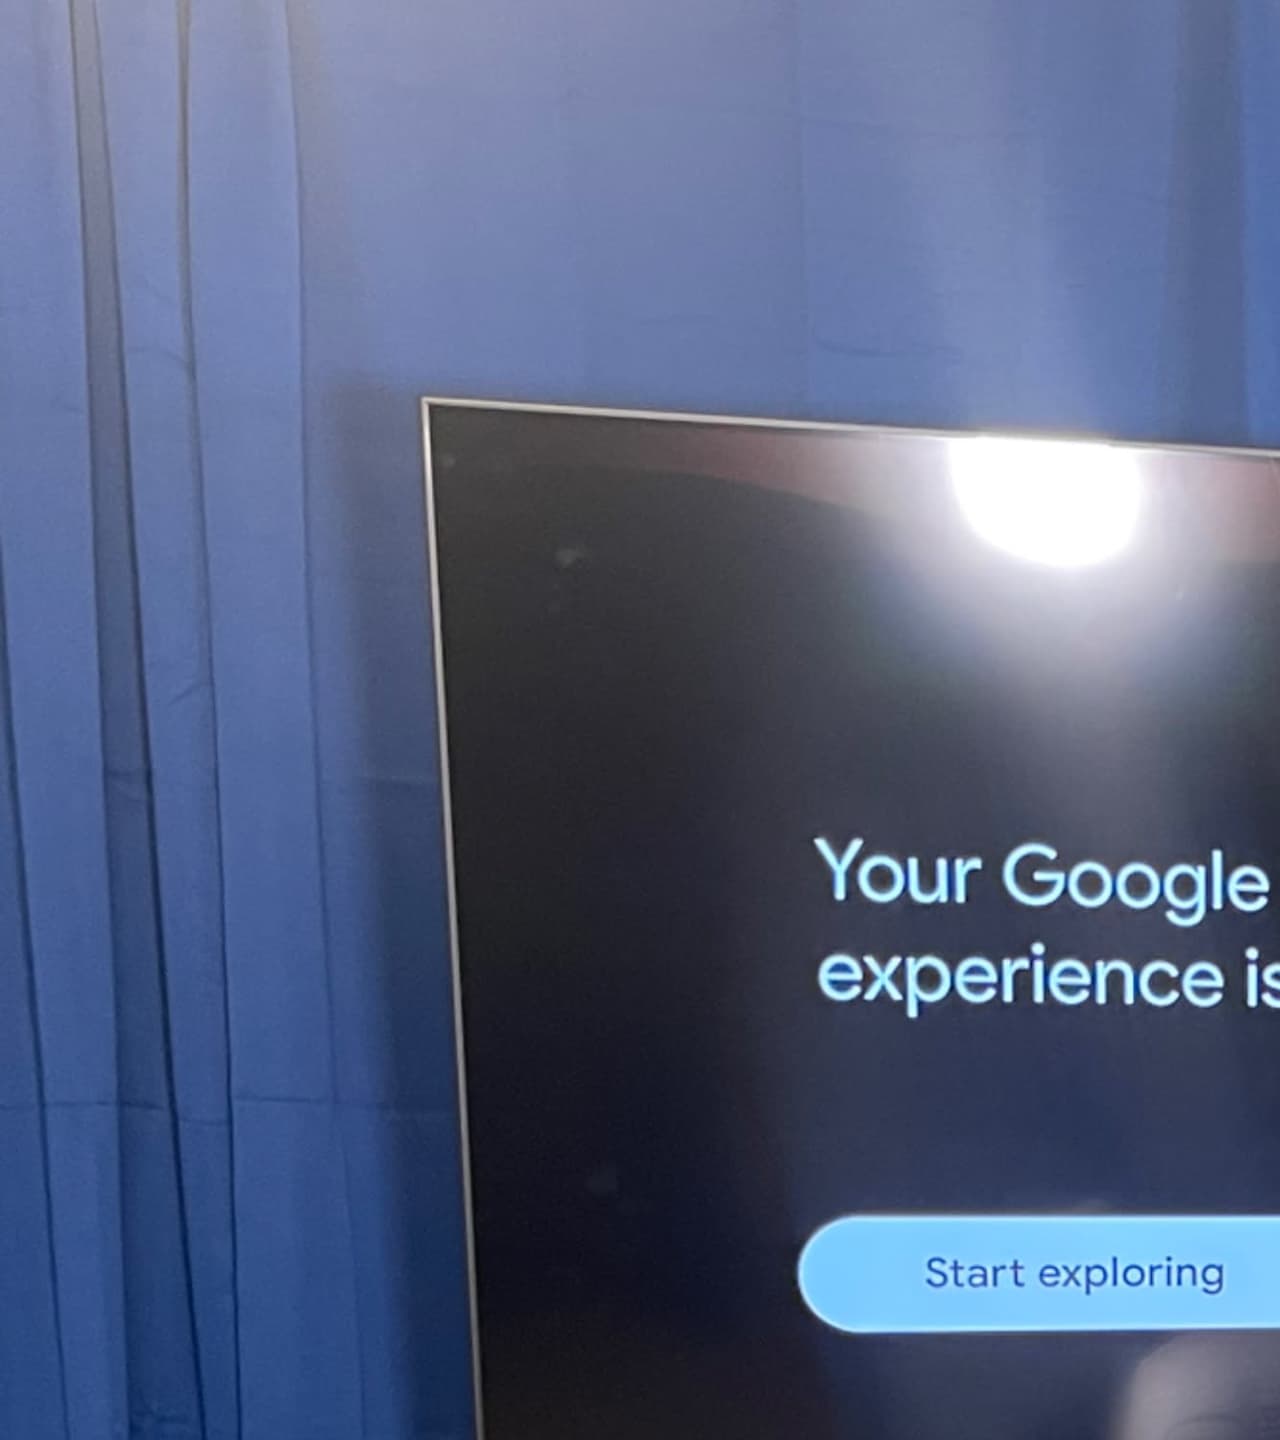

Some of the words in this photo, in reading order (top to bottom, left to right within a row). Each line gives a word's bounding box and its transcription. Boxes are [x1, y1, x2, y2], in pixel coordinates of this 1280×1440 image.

[813, 837, 983, 904] Your
[1002, 842, 1270, 927] Google
[818, 941, 1225, 1019] experience
[925, 1256, 1025, 1290] Start
[1038, 1255, 1225, 1297] exploring
